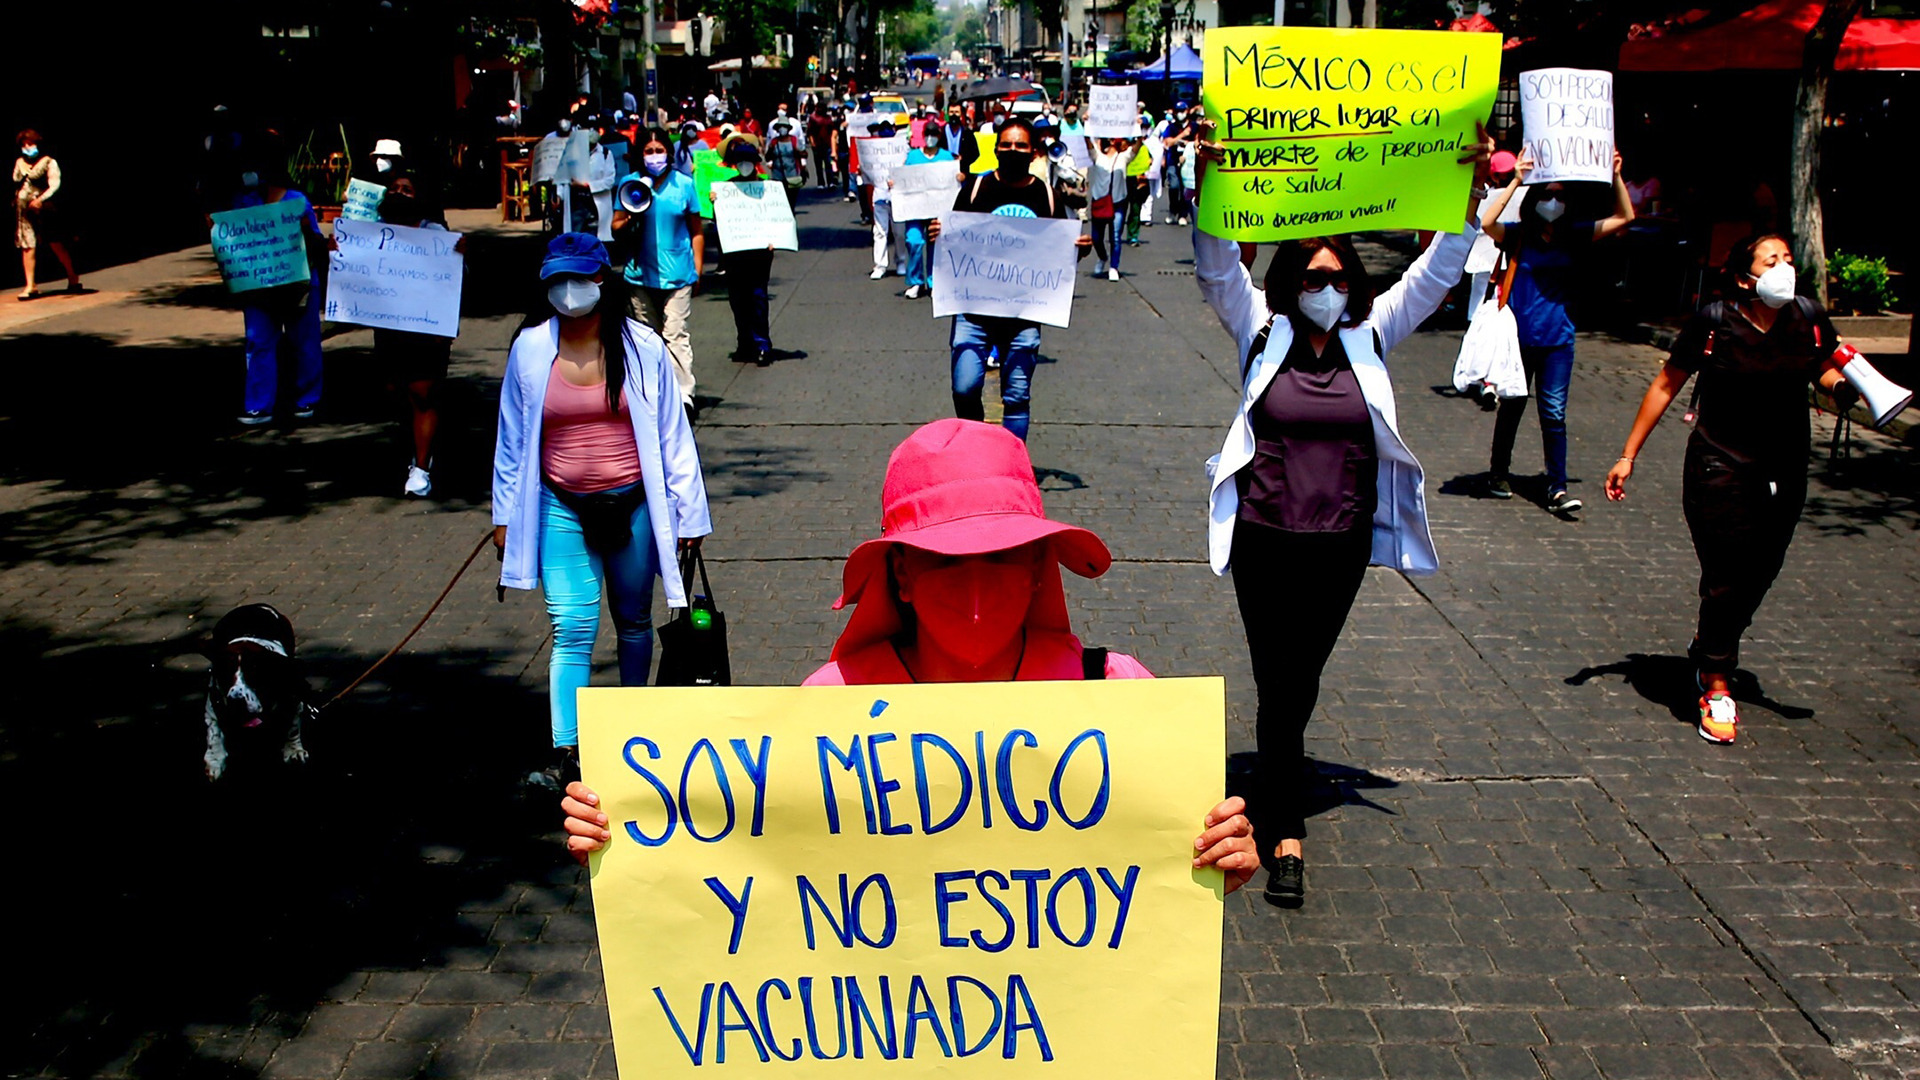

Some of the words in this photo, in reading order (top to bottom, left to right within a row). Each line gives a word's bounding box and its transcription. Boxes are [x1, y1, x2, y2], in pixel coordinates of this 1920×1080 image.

[1386, 60, 1423, 93] es
[1432, 55, 1468, 94] el
[1525, 74, 1562, 101] SOY
[1411, 107, 1440, 128] en
[1546, 102, 1573, 127] DE
[1335, 140, 1369, 162] de
[1530, 138, 1553, 169] NO
[722, 185, 739, 198] Sin
[1243, 175, 1275, 195] de
[621, 735, 771, 847] SOY
[816, 699, 1110, 836] MÉDICO
[704, 875, 754, 955] Y
[797, 872, 898, 950] NO
[934, 864, 1141, 953] ESTOY
[653, 973, 1054, 1067] VACUNADA
